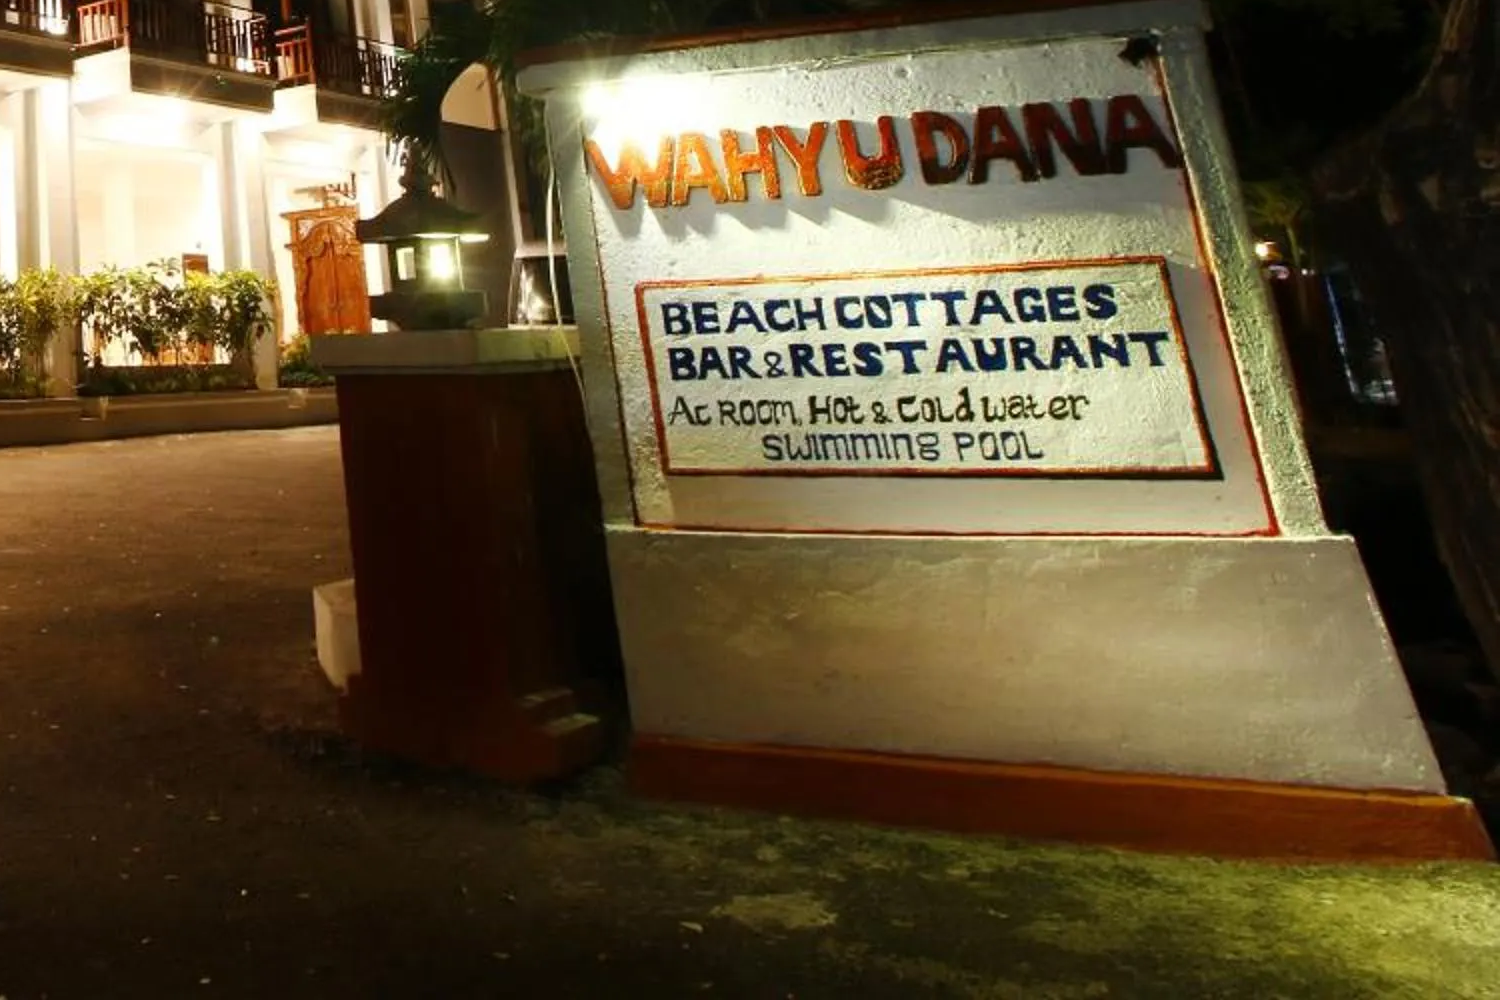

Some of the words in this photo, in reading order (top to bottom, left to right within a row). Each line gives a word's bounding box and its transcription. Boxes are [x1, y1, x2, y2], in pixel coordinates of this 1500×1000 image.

[661, 296, 827, 336] BEACH
[833, 283, 1118, 329] COTTAGES
[871, 400, 893, 424] &
[952, 430, 1045, 461] POOL
